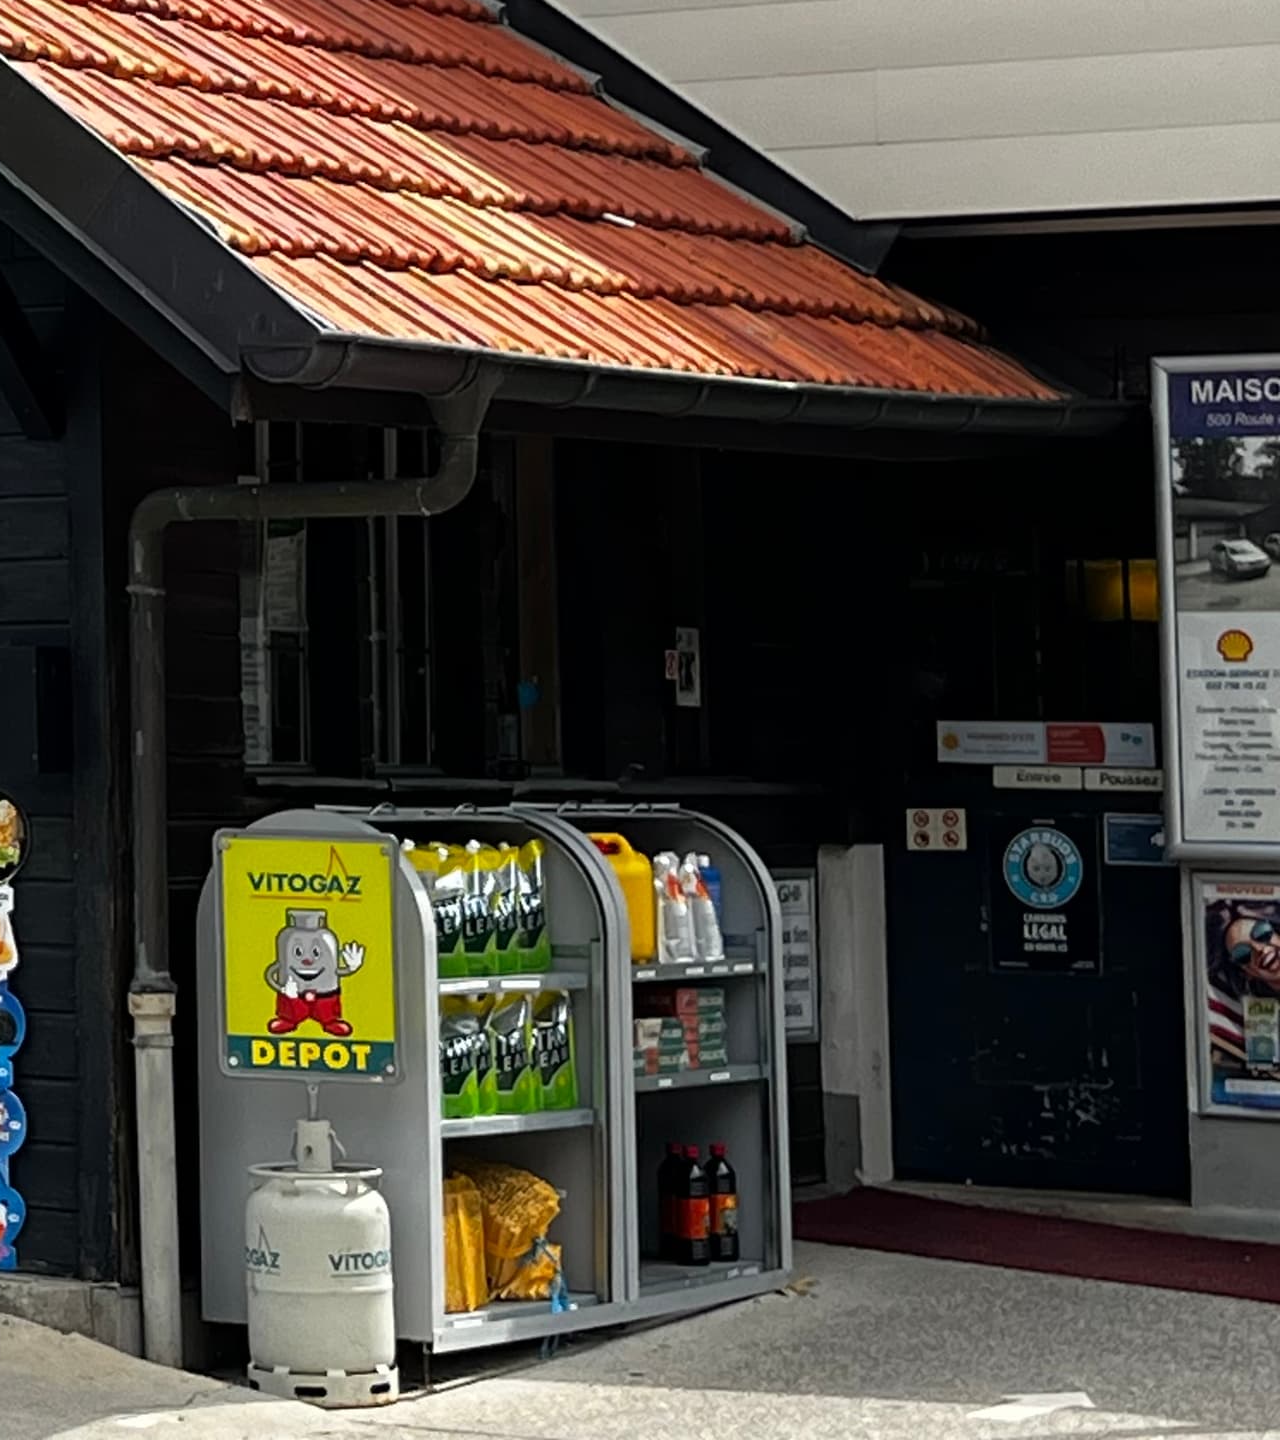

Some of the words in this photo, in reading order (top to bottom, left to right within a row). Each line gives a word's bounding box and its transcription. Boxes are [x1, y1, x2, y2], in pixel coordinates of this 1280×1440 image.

[1099, 772, 1159, 788] Poussez
[246, 871, 363, 896] VITOGAZ
[1022, 922, 1069, 941] LEGAL
[251, 1039, 371, 1070] DEPOT
[328, 1250, 390, 1271] VITOG
